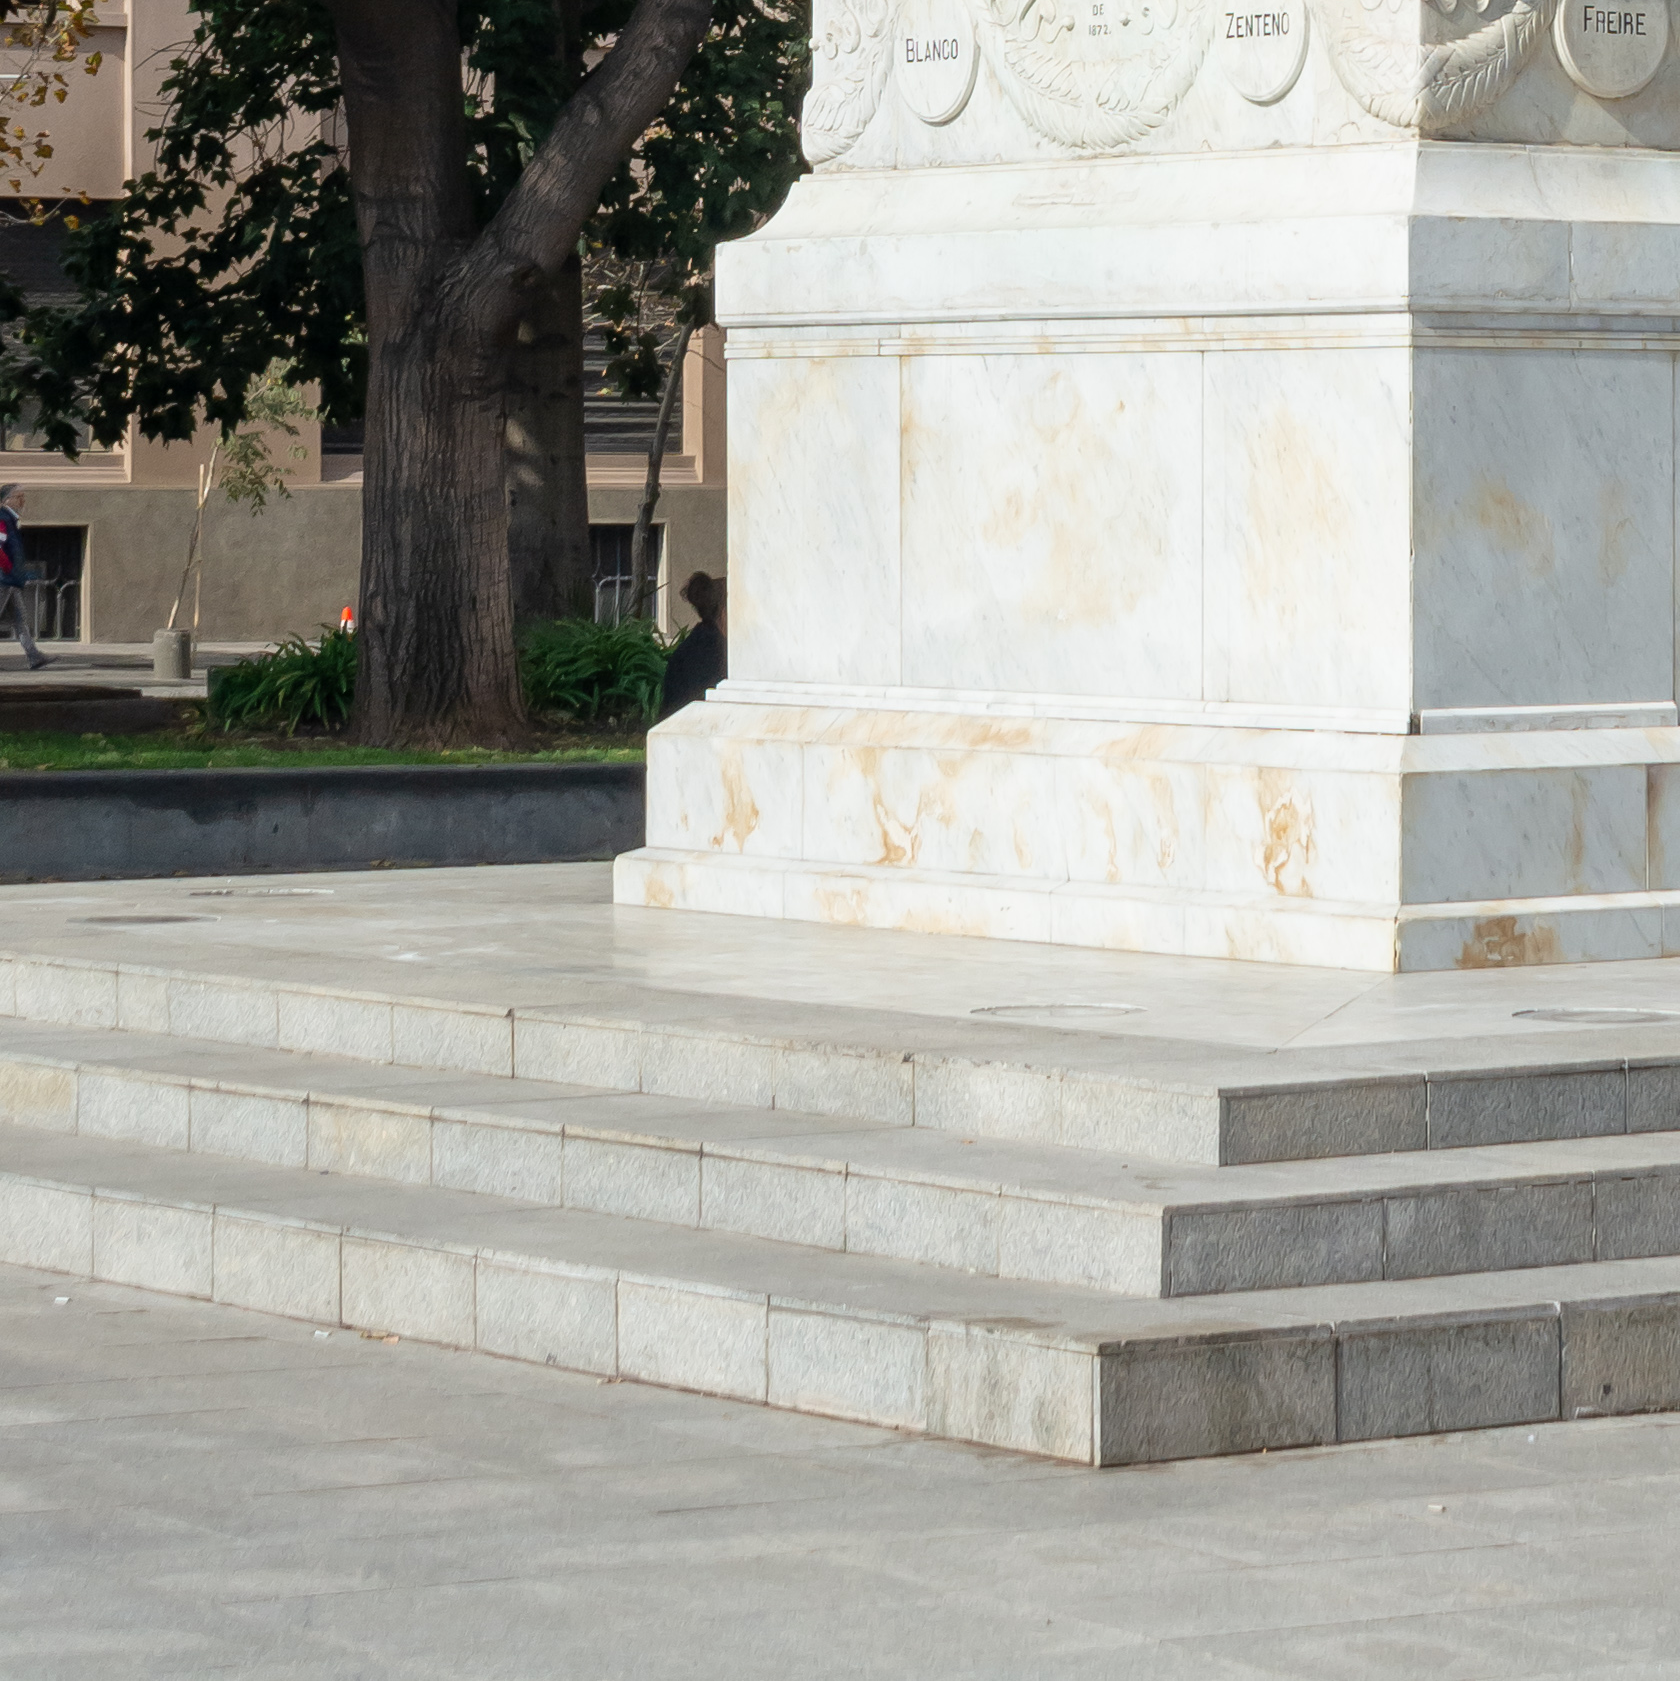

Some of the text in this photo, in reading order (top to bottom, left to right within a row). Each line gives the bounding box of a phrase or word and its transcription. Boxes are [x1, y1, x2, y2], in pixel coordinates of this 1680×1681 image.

[1092, 3, 1104, 16] DE
[1583, 5, 1647, 36] FREIRE
[1225, 12, 1290, 39] ZENTENO
[906, 38, 959, 63] BLANCO
